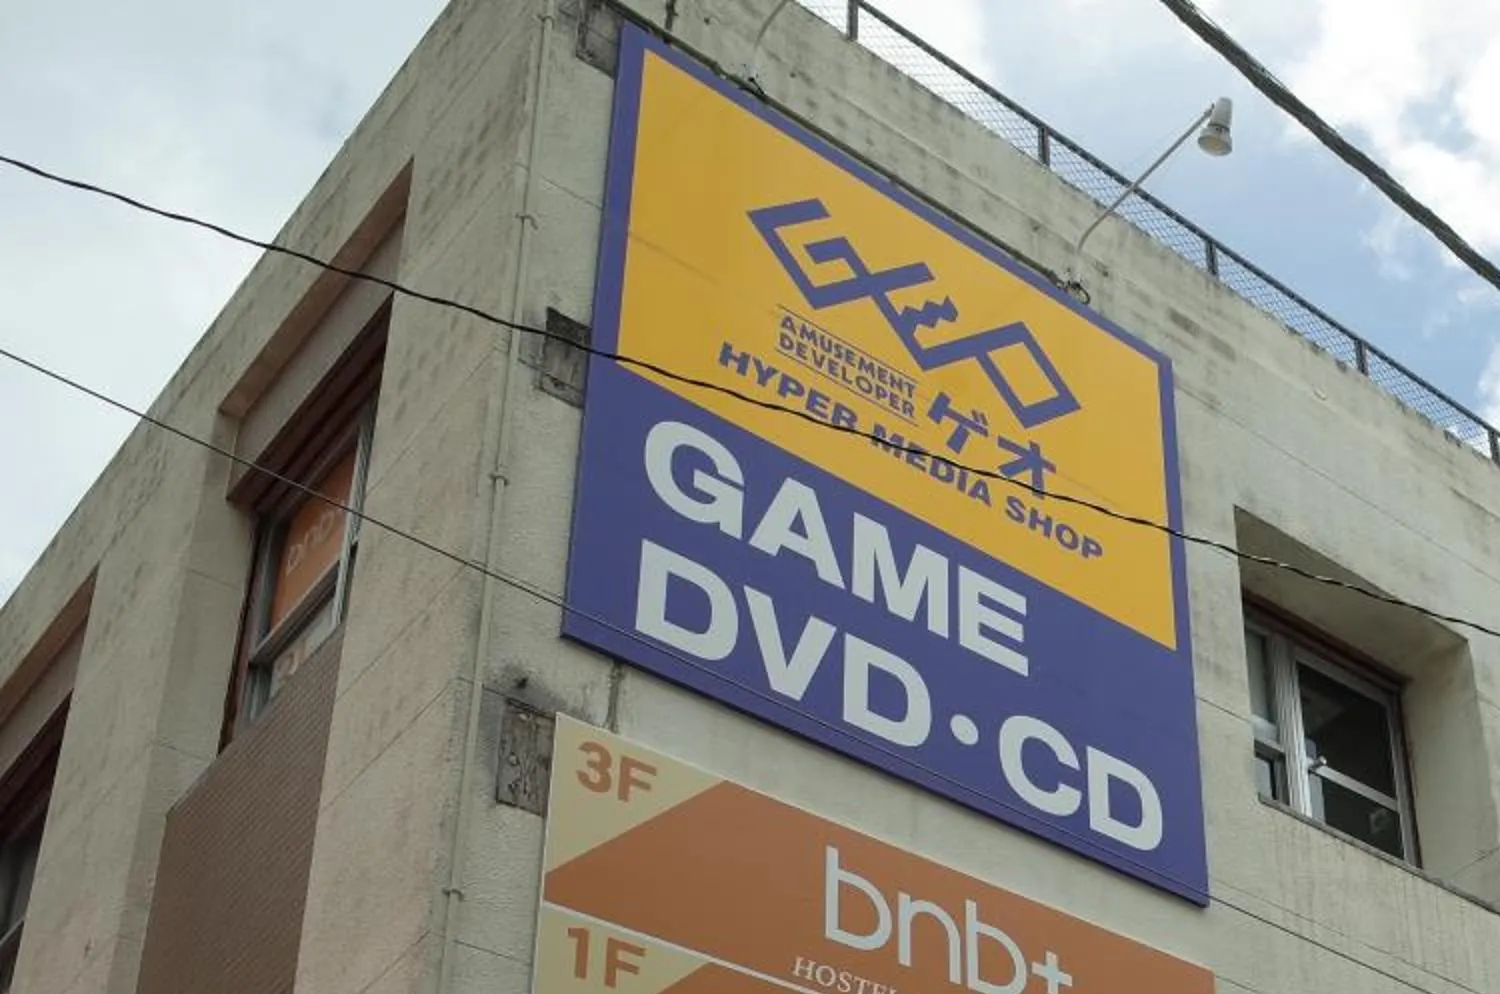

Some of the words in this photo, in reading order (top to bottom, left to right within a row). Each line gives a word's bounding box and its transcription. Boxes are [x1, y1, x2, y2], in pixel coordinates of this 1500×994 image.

[779, 332, 915, 418] DEVELOPER
[780, 315, 916, 399] AMUSEMENT
[718, 340, 859, 431] HYPER
[870, 421, 993, 508] MEDIA
[1004, 495, 1103, 559] SHOP
[927, 391, 1057, 500] ゲオ
[644, 420, 1031, 678] GAME
[576, 741, 658, 804] 3F
[566, 926, 647, 990] 1F
